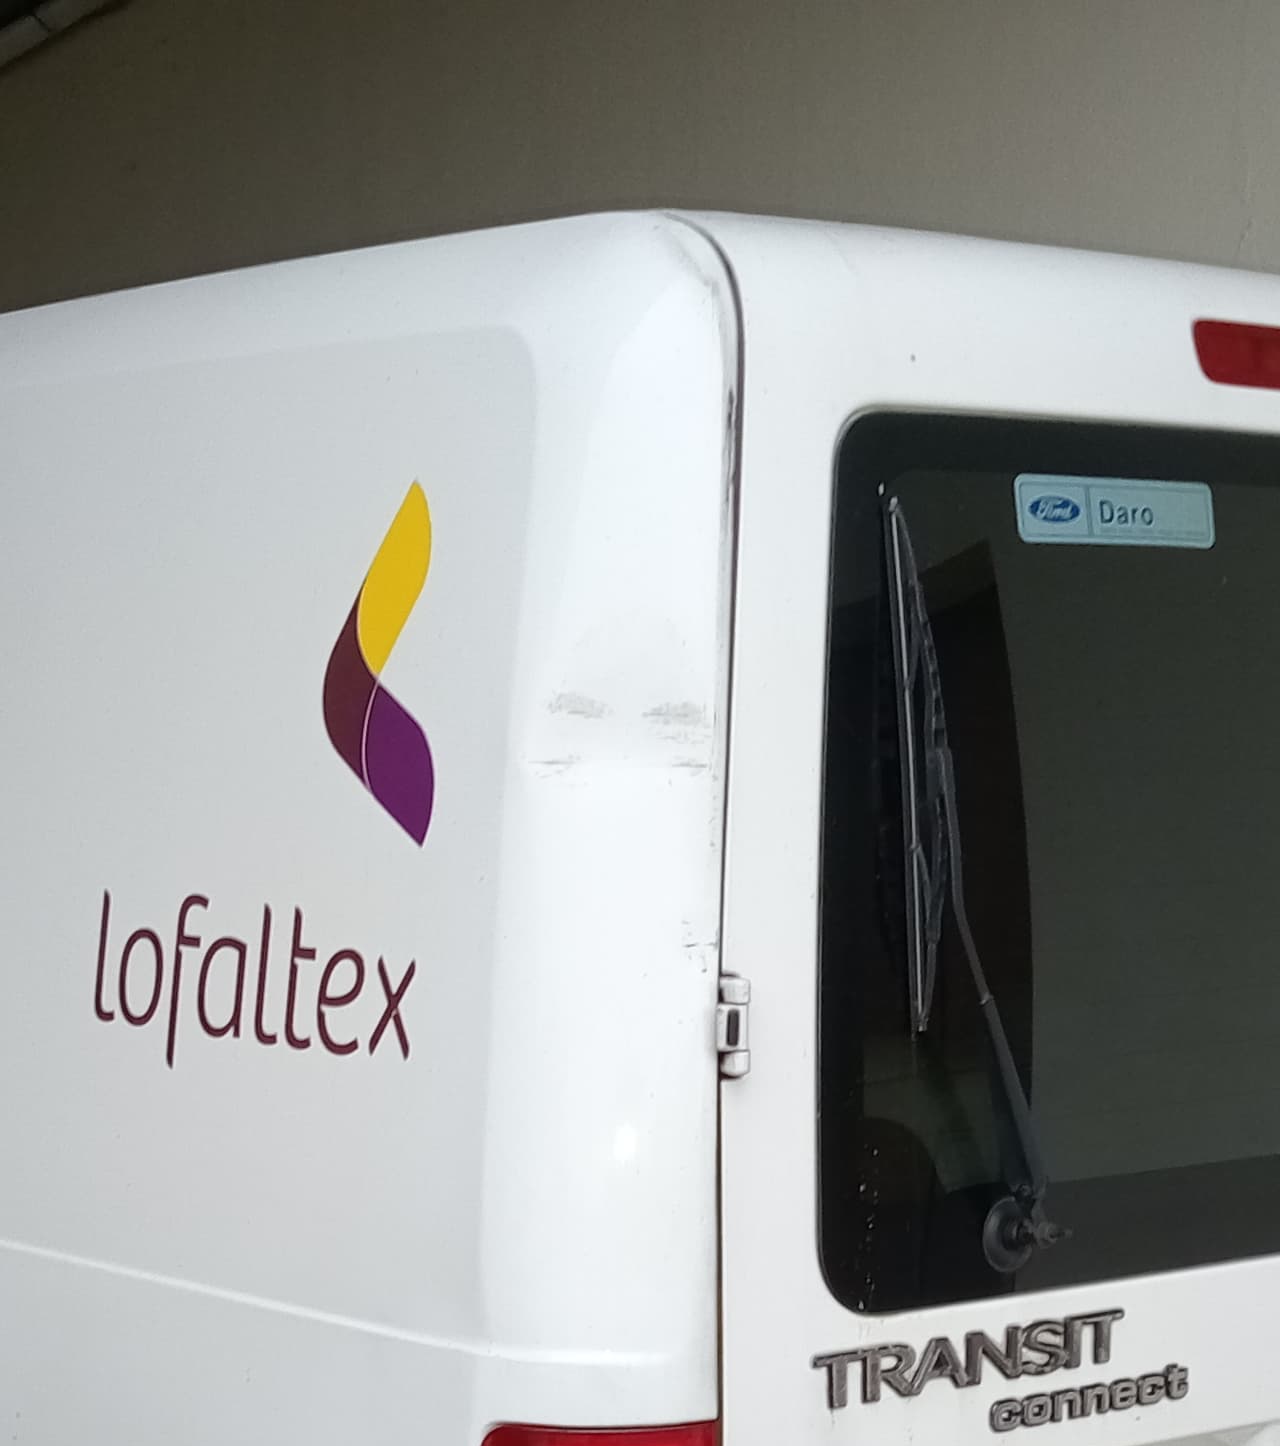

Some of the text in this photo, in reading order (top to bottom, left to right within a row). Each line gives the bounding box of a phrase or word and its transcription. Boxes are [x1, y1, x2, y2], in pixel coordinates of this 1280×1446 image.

[1099, 500, 1154, 526] Daro
[94, 888, 417, 1069] lofaltex
[811, 1308, 1125, 1410] TRANSIT
[989, 1363, 1190, 1432] connect
